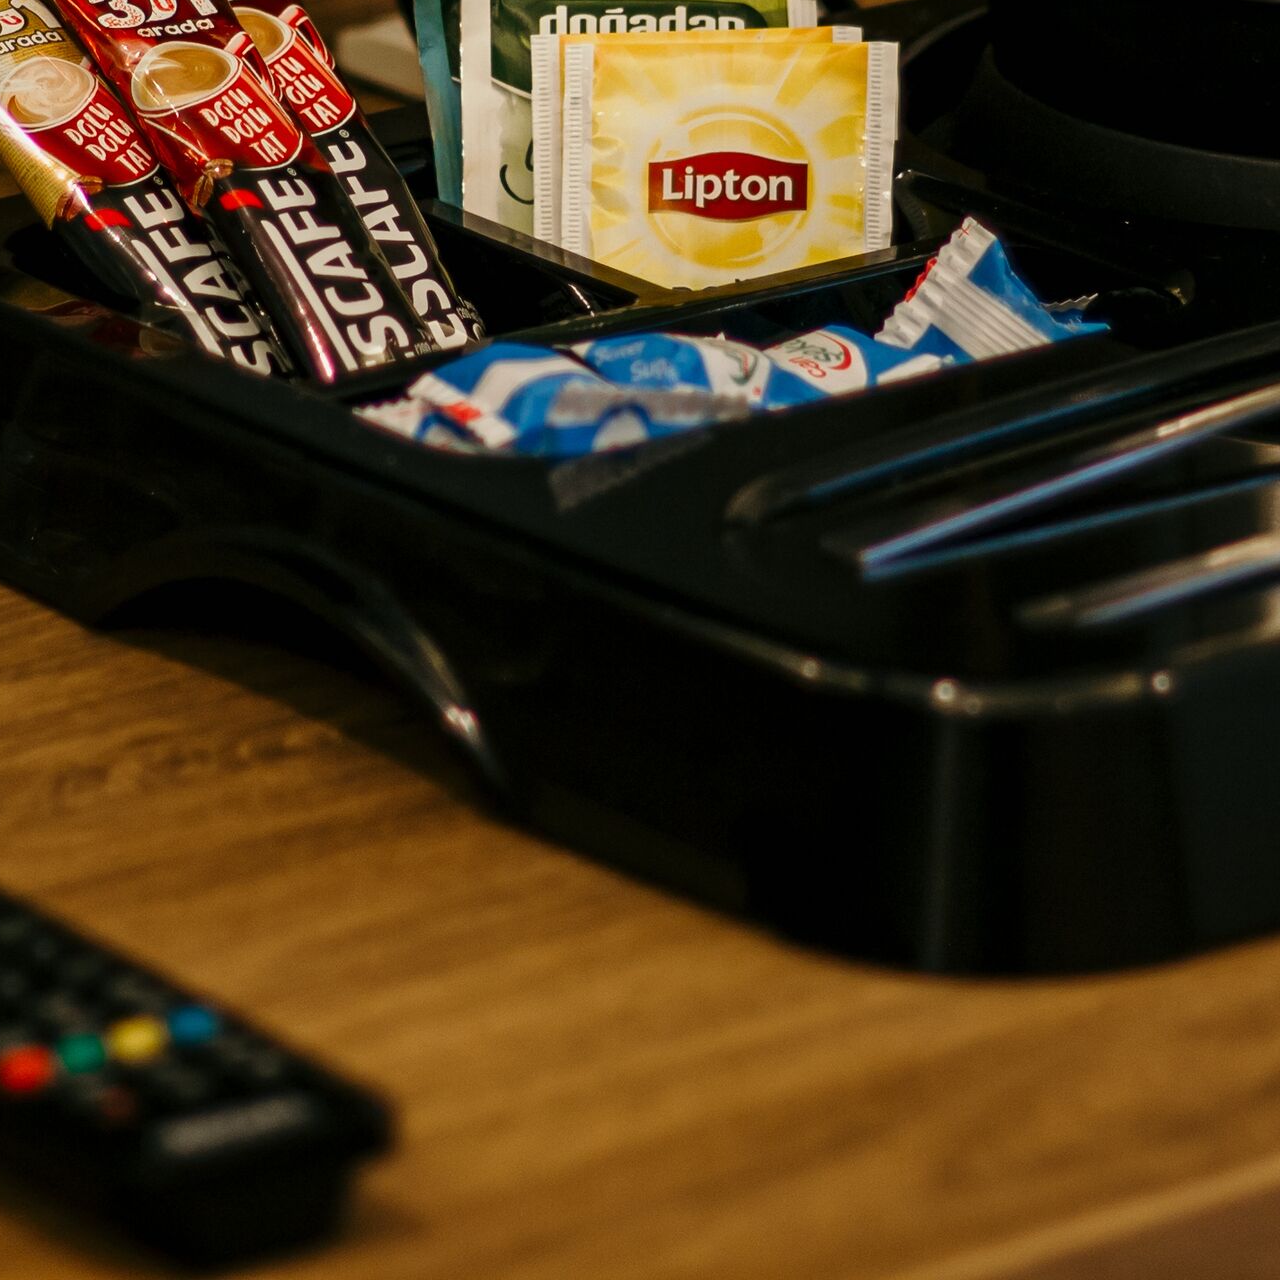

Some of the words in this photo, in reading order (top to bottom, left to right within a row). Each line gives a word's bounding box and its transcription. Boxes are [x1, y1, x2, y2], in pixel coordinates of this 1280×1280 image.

[136, 18, 215, 39] arada
[198, 87, 254, 127] DOLU
[285, 73, 326, 105] OLU
[62, 102, 114, 146] DOLU
[220, 106, 273, 145] DOLU
[299, 94, 342, 128] TAT
[84, 118, 135, 162] DOLU
[113, 140, 152, 176] TAT
[248, 130, 288, 164] TAT
[661, 166, 794, 208] Lipton
